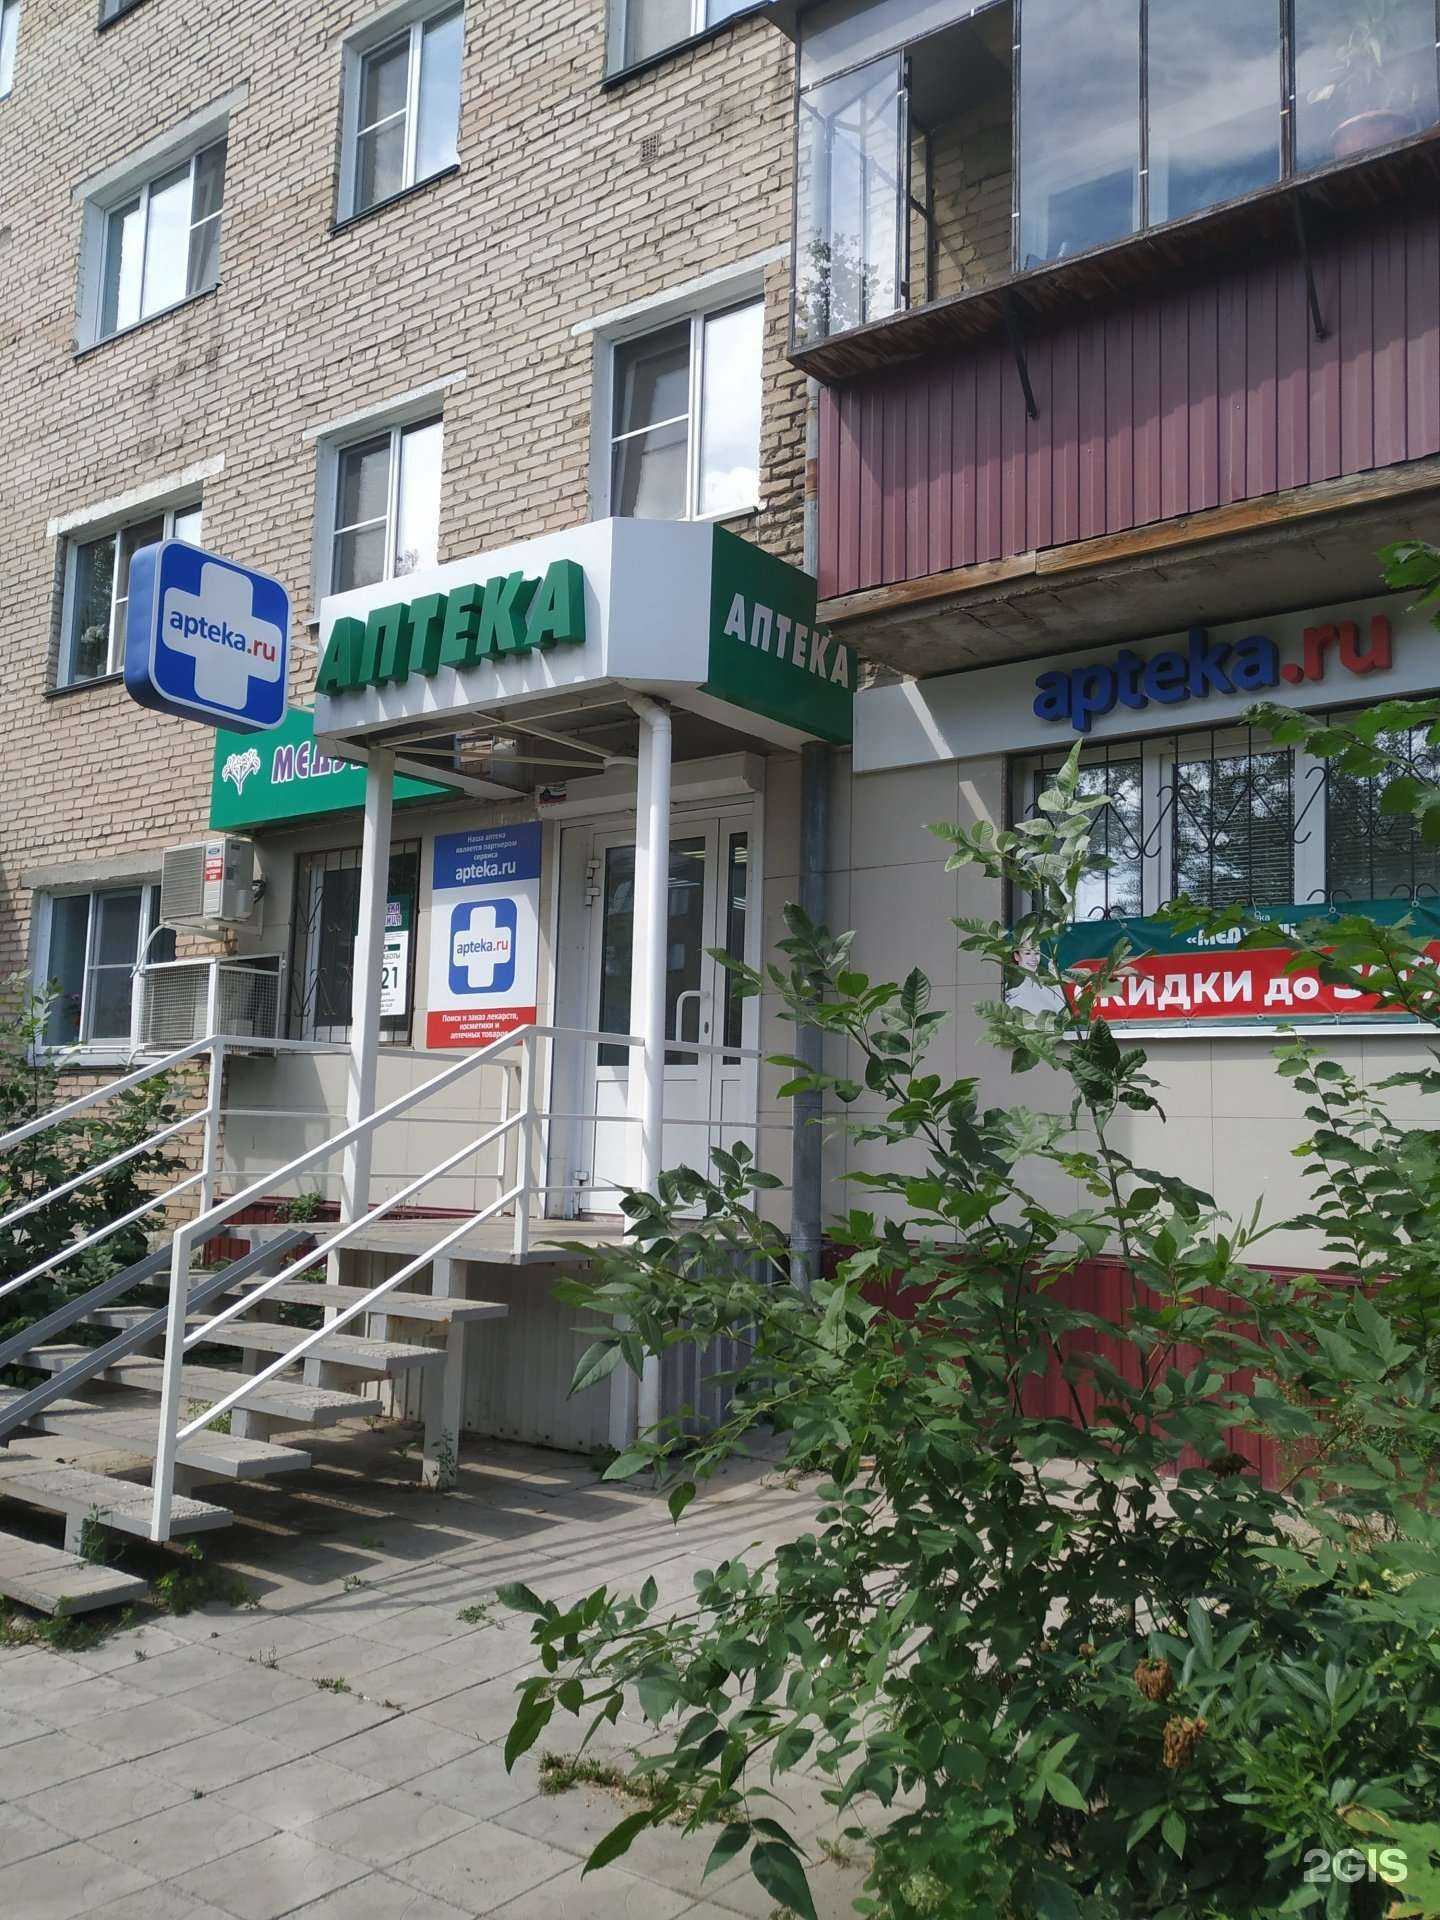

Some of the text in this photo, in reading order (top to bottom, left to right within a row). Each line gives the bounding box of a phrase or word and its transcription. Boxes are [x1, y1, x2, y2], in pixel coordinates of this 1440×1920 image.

[169, 610, 276, 662] apteka.ru
[315, 559, 586, 696] АПТЕКА
[723, 592, 849, 688] АПТЕКА
[1033, 614, 1393, 733] apteka.ru
[467, 833, 506, 844] Наша аптека
[455, 860, 517, 883] apteka.ru
[456, 937, 509, 957] apteka.ru
[1264, 976, 1319, 1006] до
[442, 1014, 462, 1023] Поиск
[459, 1022, 494, 1031] косметики
[450, 1030, 481, 1040] аптечных
